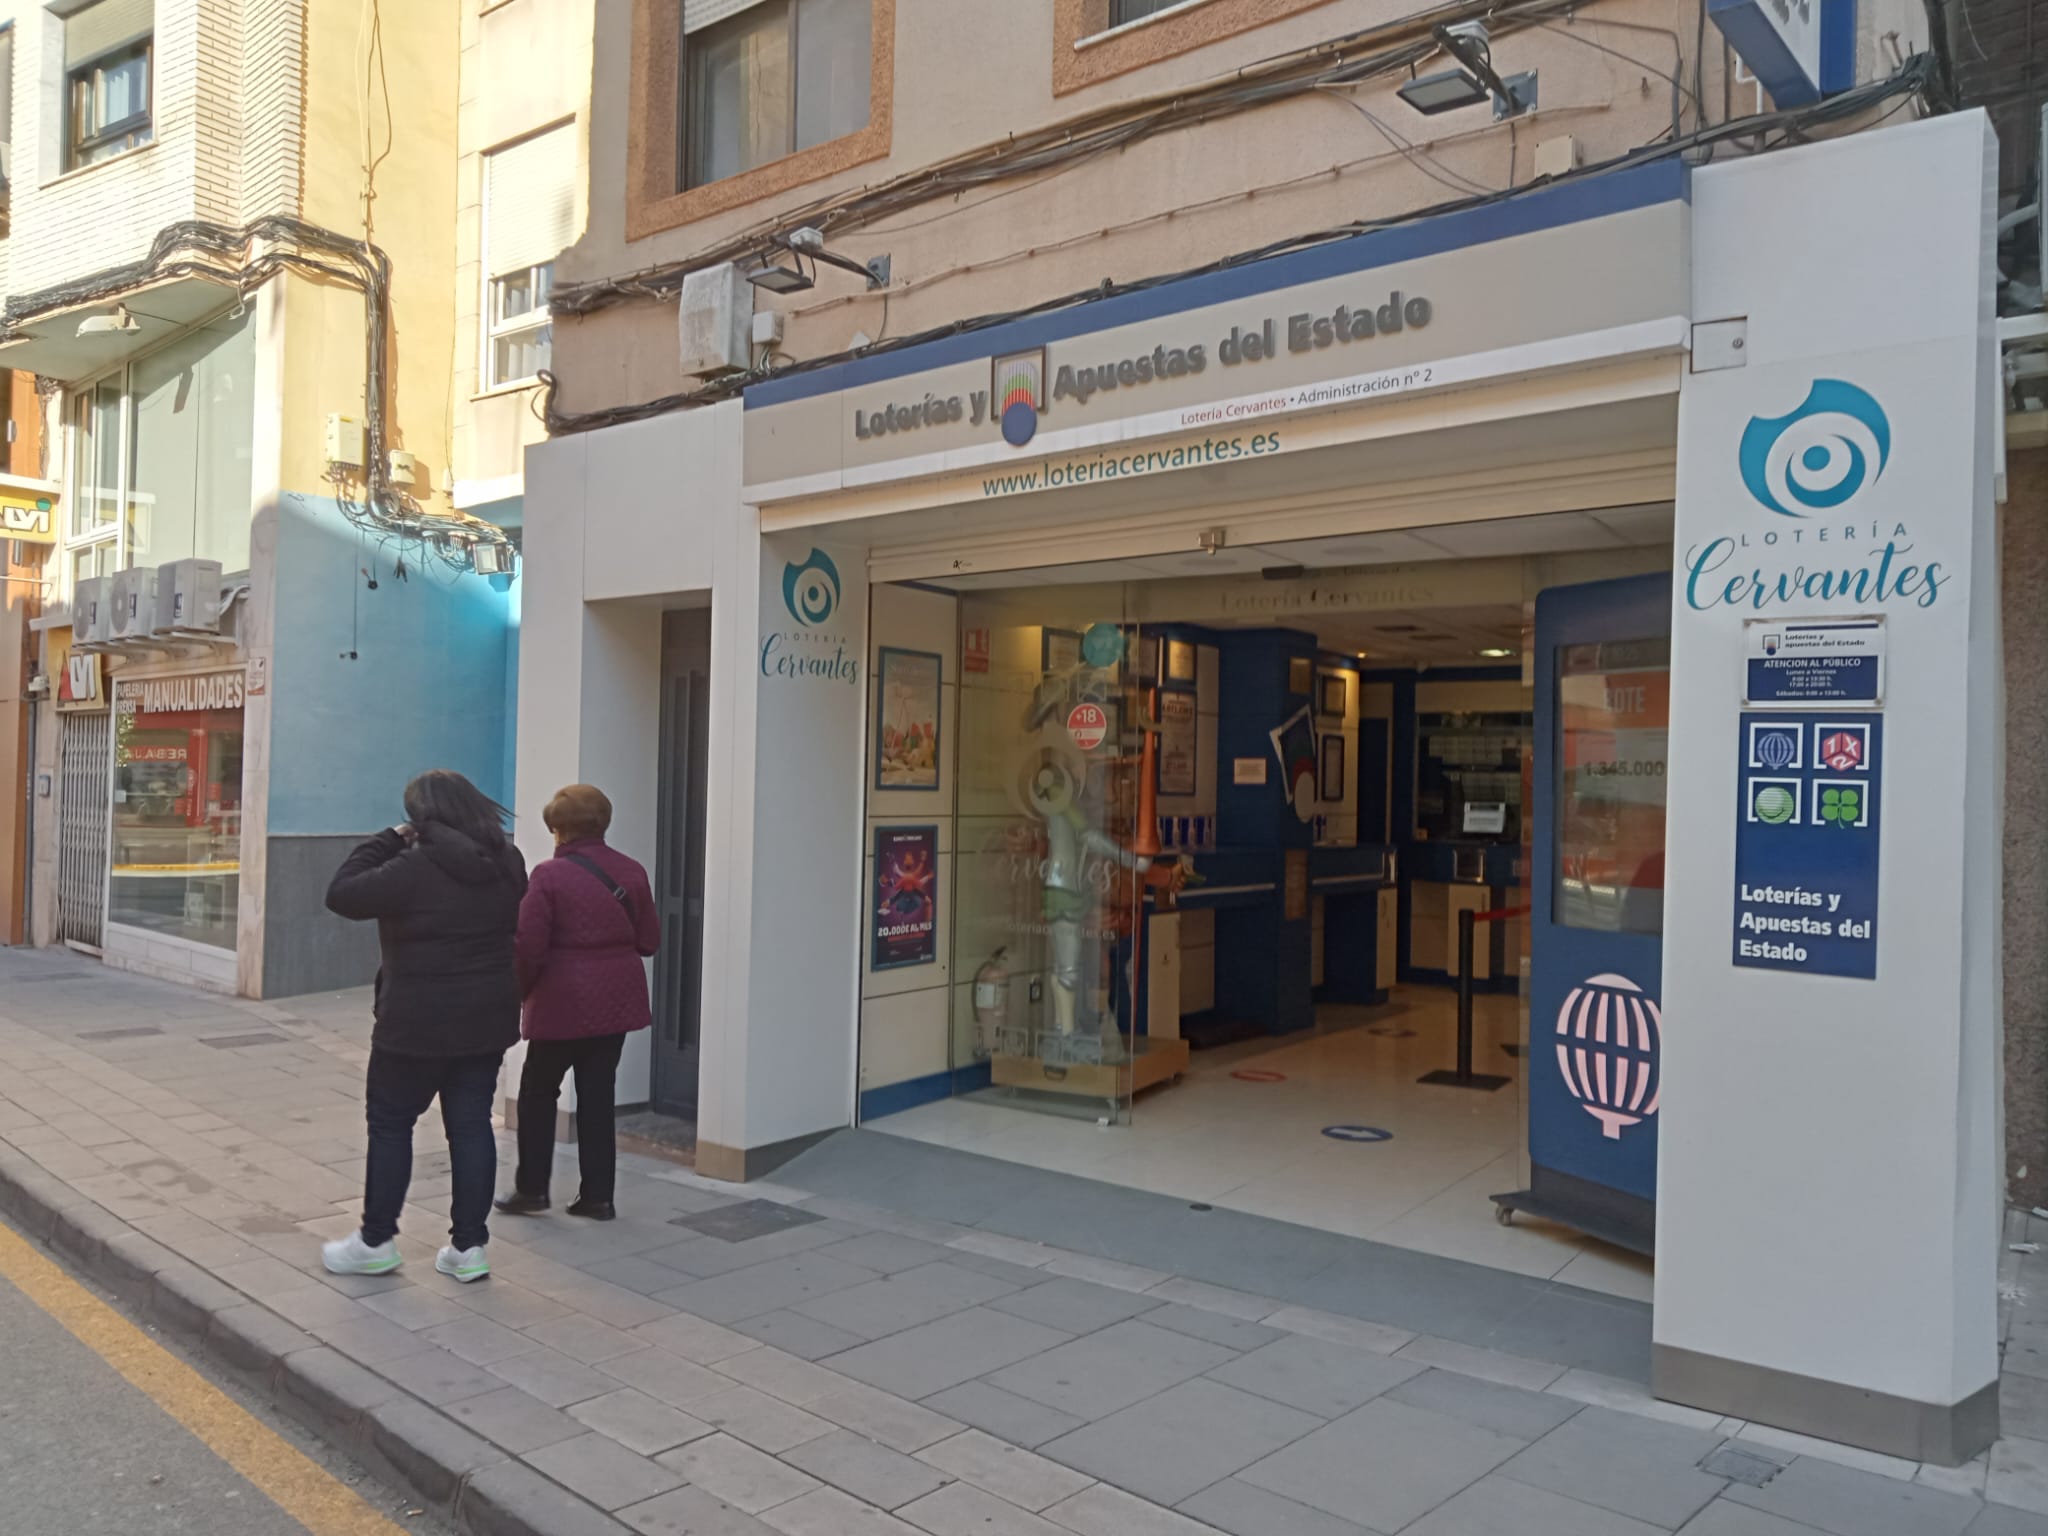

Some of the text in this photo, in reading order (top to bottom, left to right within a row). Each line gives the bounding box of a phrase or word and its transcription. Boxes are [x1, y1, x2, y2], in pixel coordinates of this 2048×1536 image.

[1053, 291, 1431, 405] Apuestas del Estado
[855, 390, 986, 439] Loterías y
[1181, 408, 1222, 425] Lotería
[1226, 397, 1286, 417] Cervantes
[1298, 378, 1399, 405] Administración
[1424, 369, 1433, 382] 2
[983, 430, 1280, 497] www.loteriacervantes.es
[1742, 520, 1906, 547] LOTERÍA
[1685, 537, 1951, 611] Cervantes
[761, 632, 858, 685] Cervantes
[1810, 659, 1821, 667] AL
[144, 674, 243, 713] MANUALIDADES
[1741, 884, 1841, 912] Loterías y
[1740, 912, 1870, 938] Apuestas del
[1740, 939, 1807, 961] Estado
